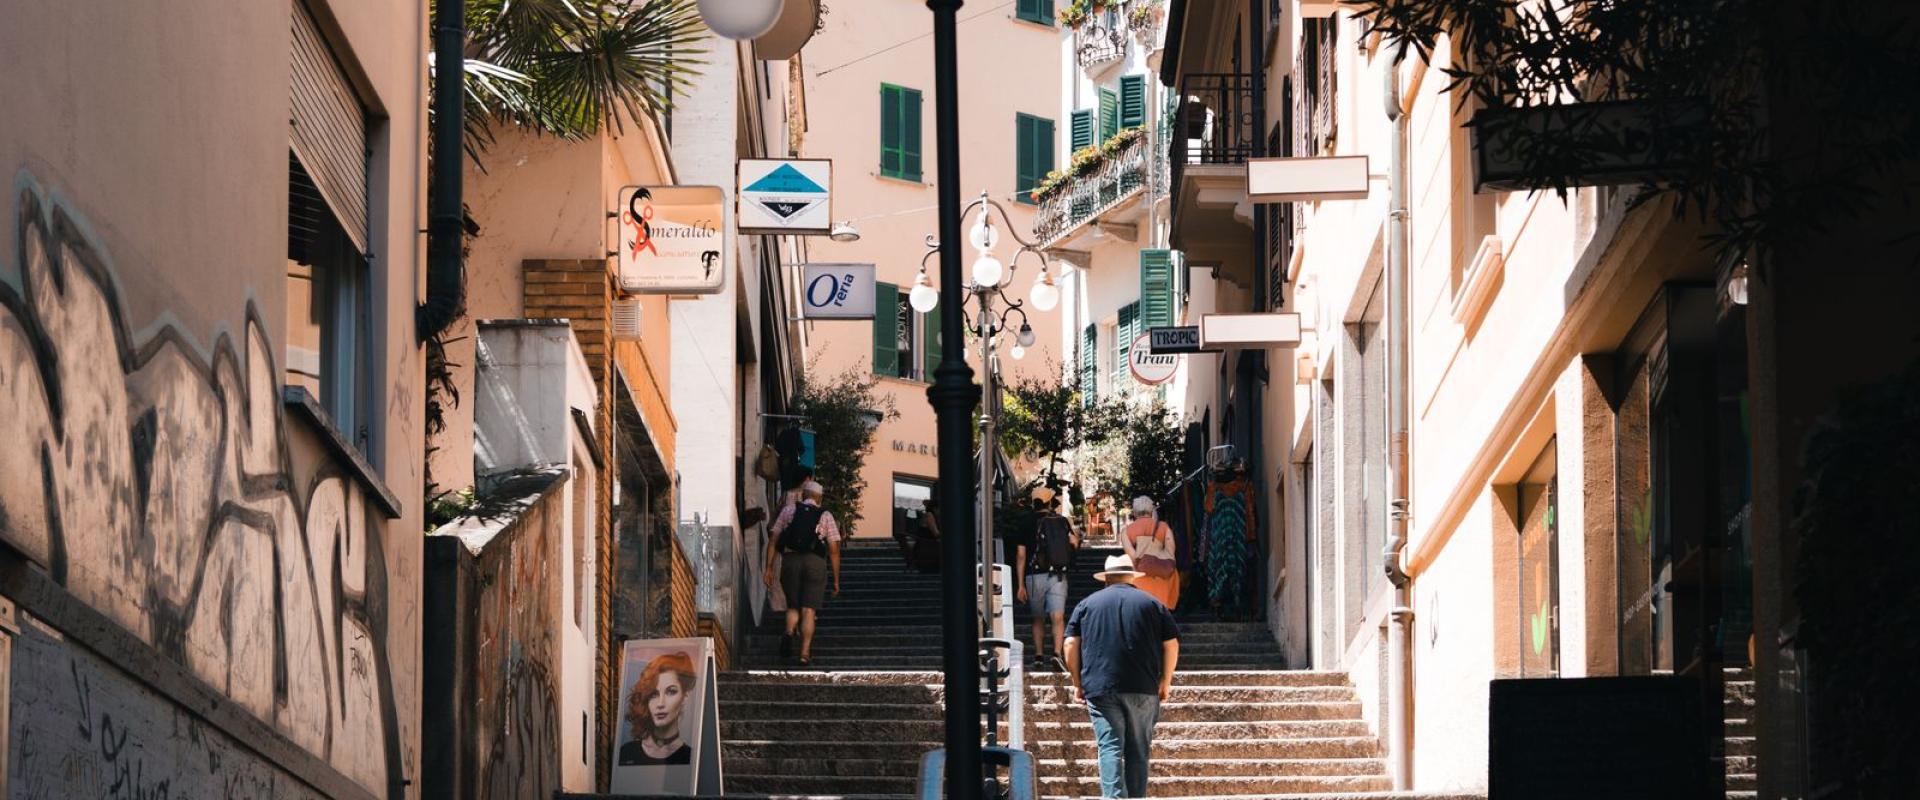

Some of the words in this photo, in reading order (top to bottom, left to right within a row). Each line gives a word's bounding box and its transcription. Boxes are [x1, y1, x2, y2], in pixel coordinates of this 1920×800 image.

[628, 187, 716, 250] Smeraldo
[807, 273, 855, 308] Oreria
[1154, 331, 1198, 345] TROPIC
[1134, 350, 1175, 365] Trani
